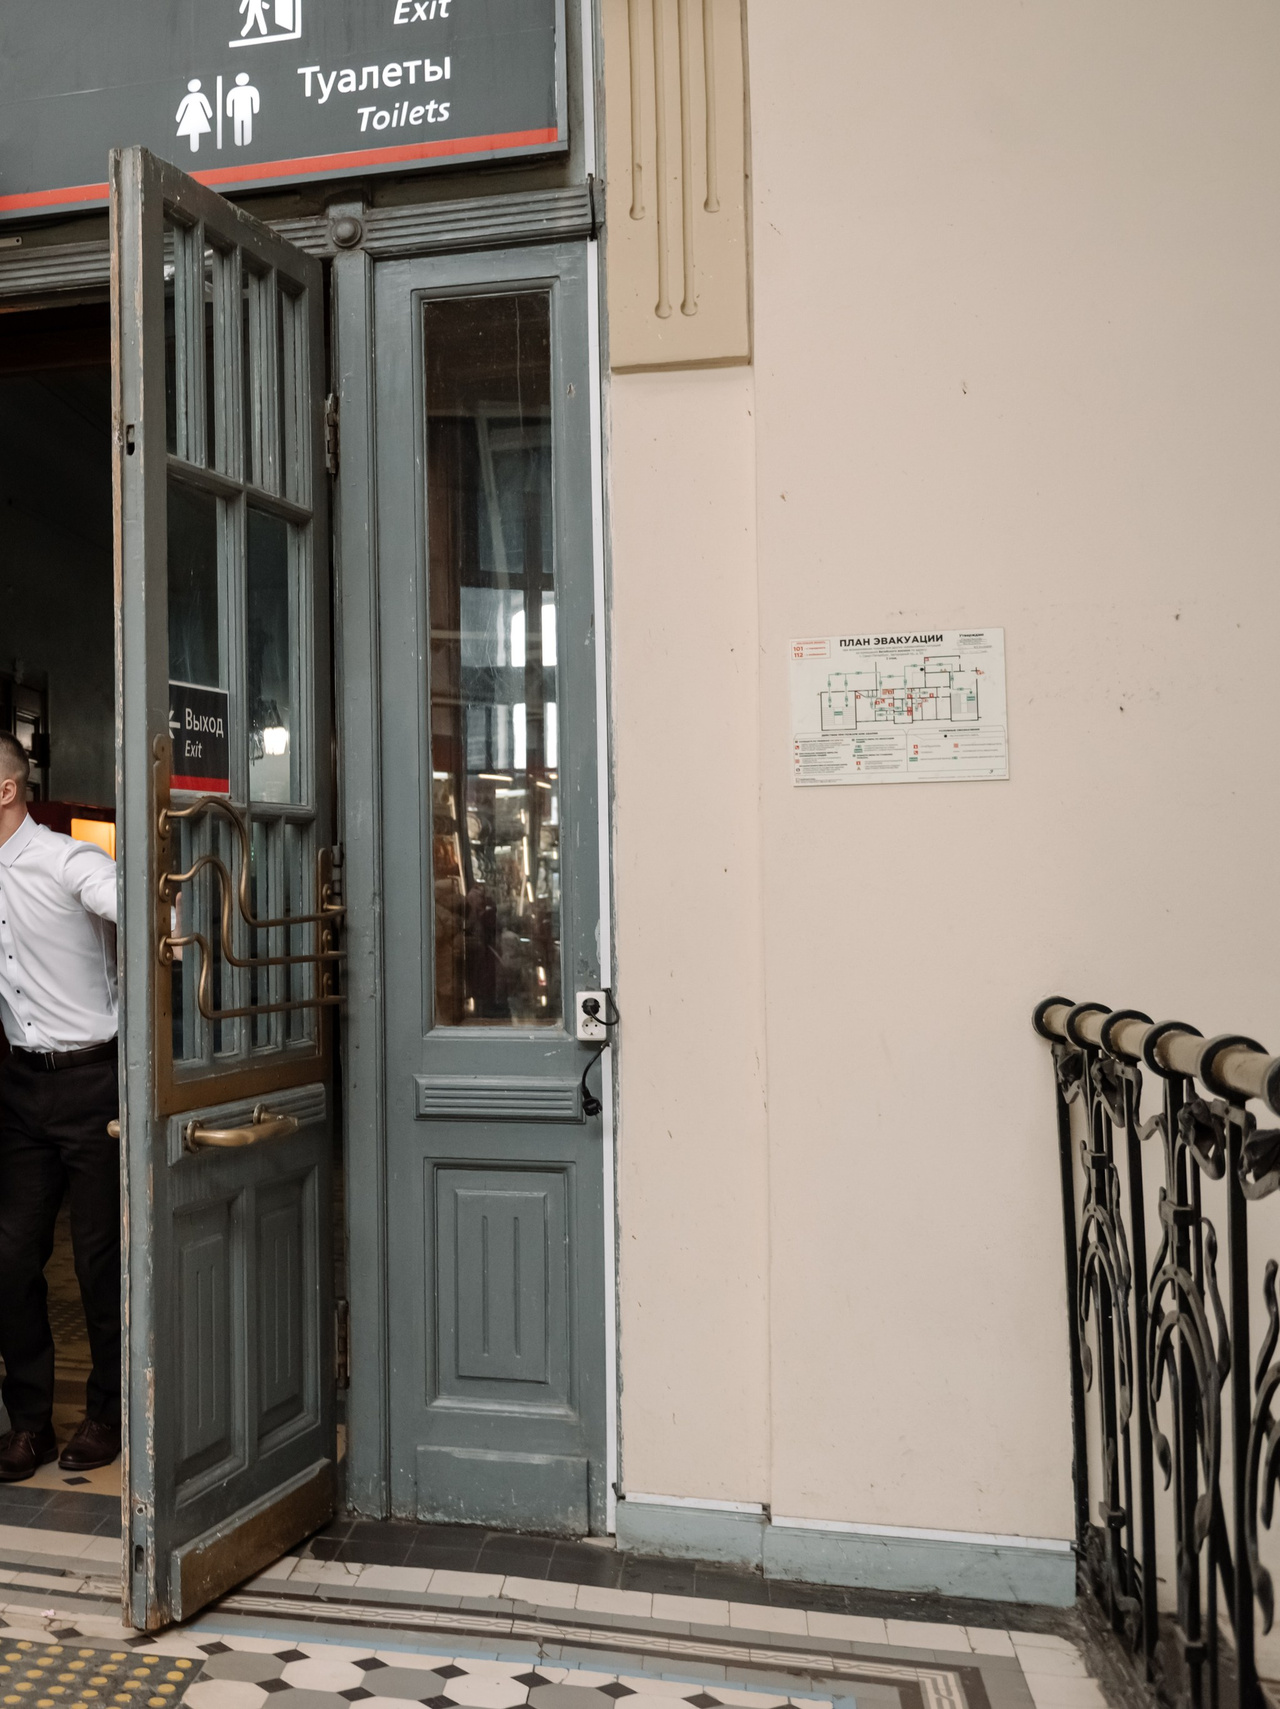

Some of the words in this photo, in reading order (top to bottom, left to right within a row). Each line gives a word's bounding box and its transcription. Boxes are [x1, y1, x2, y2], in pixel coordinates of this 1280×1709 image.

[393, 0, 452, 25] Exit
[297, 56, 451, 104] Туалеты
[357, 99, 451, 132] Toilets
[839, 638, 871, 647] ПЛАН
[873, 634, 944, 646] ЭВАКУАЦИИ
[185, 707, 224, 738] Выход
[184, 740, 203, 758] Exit
